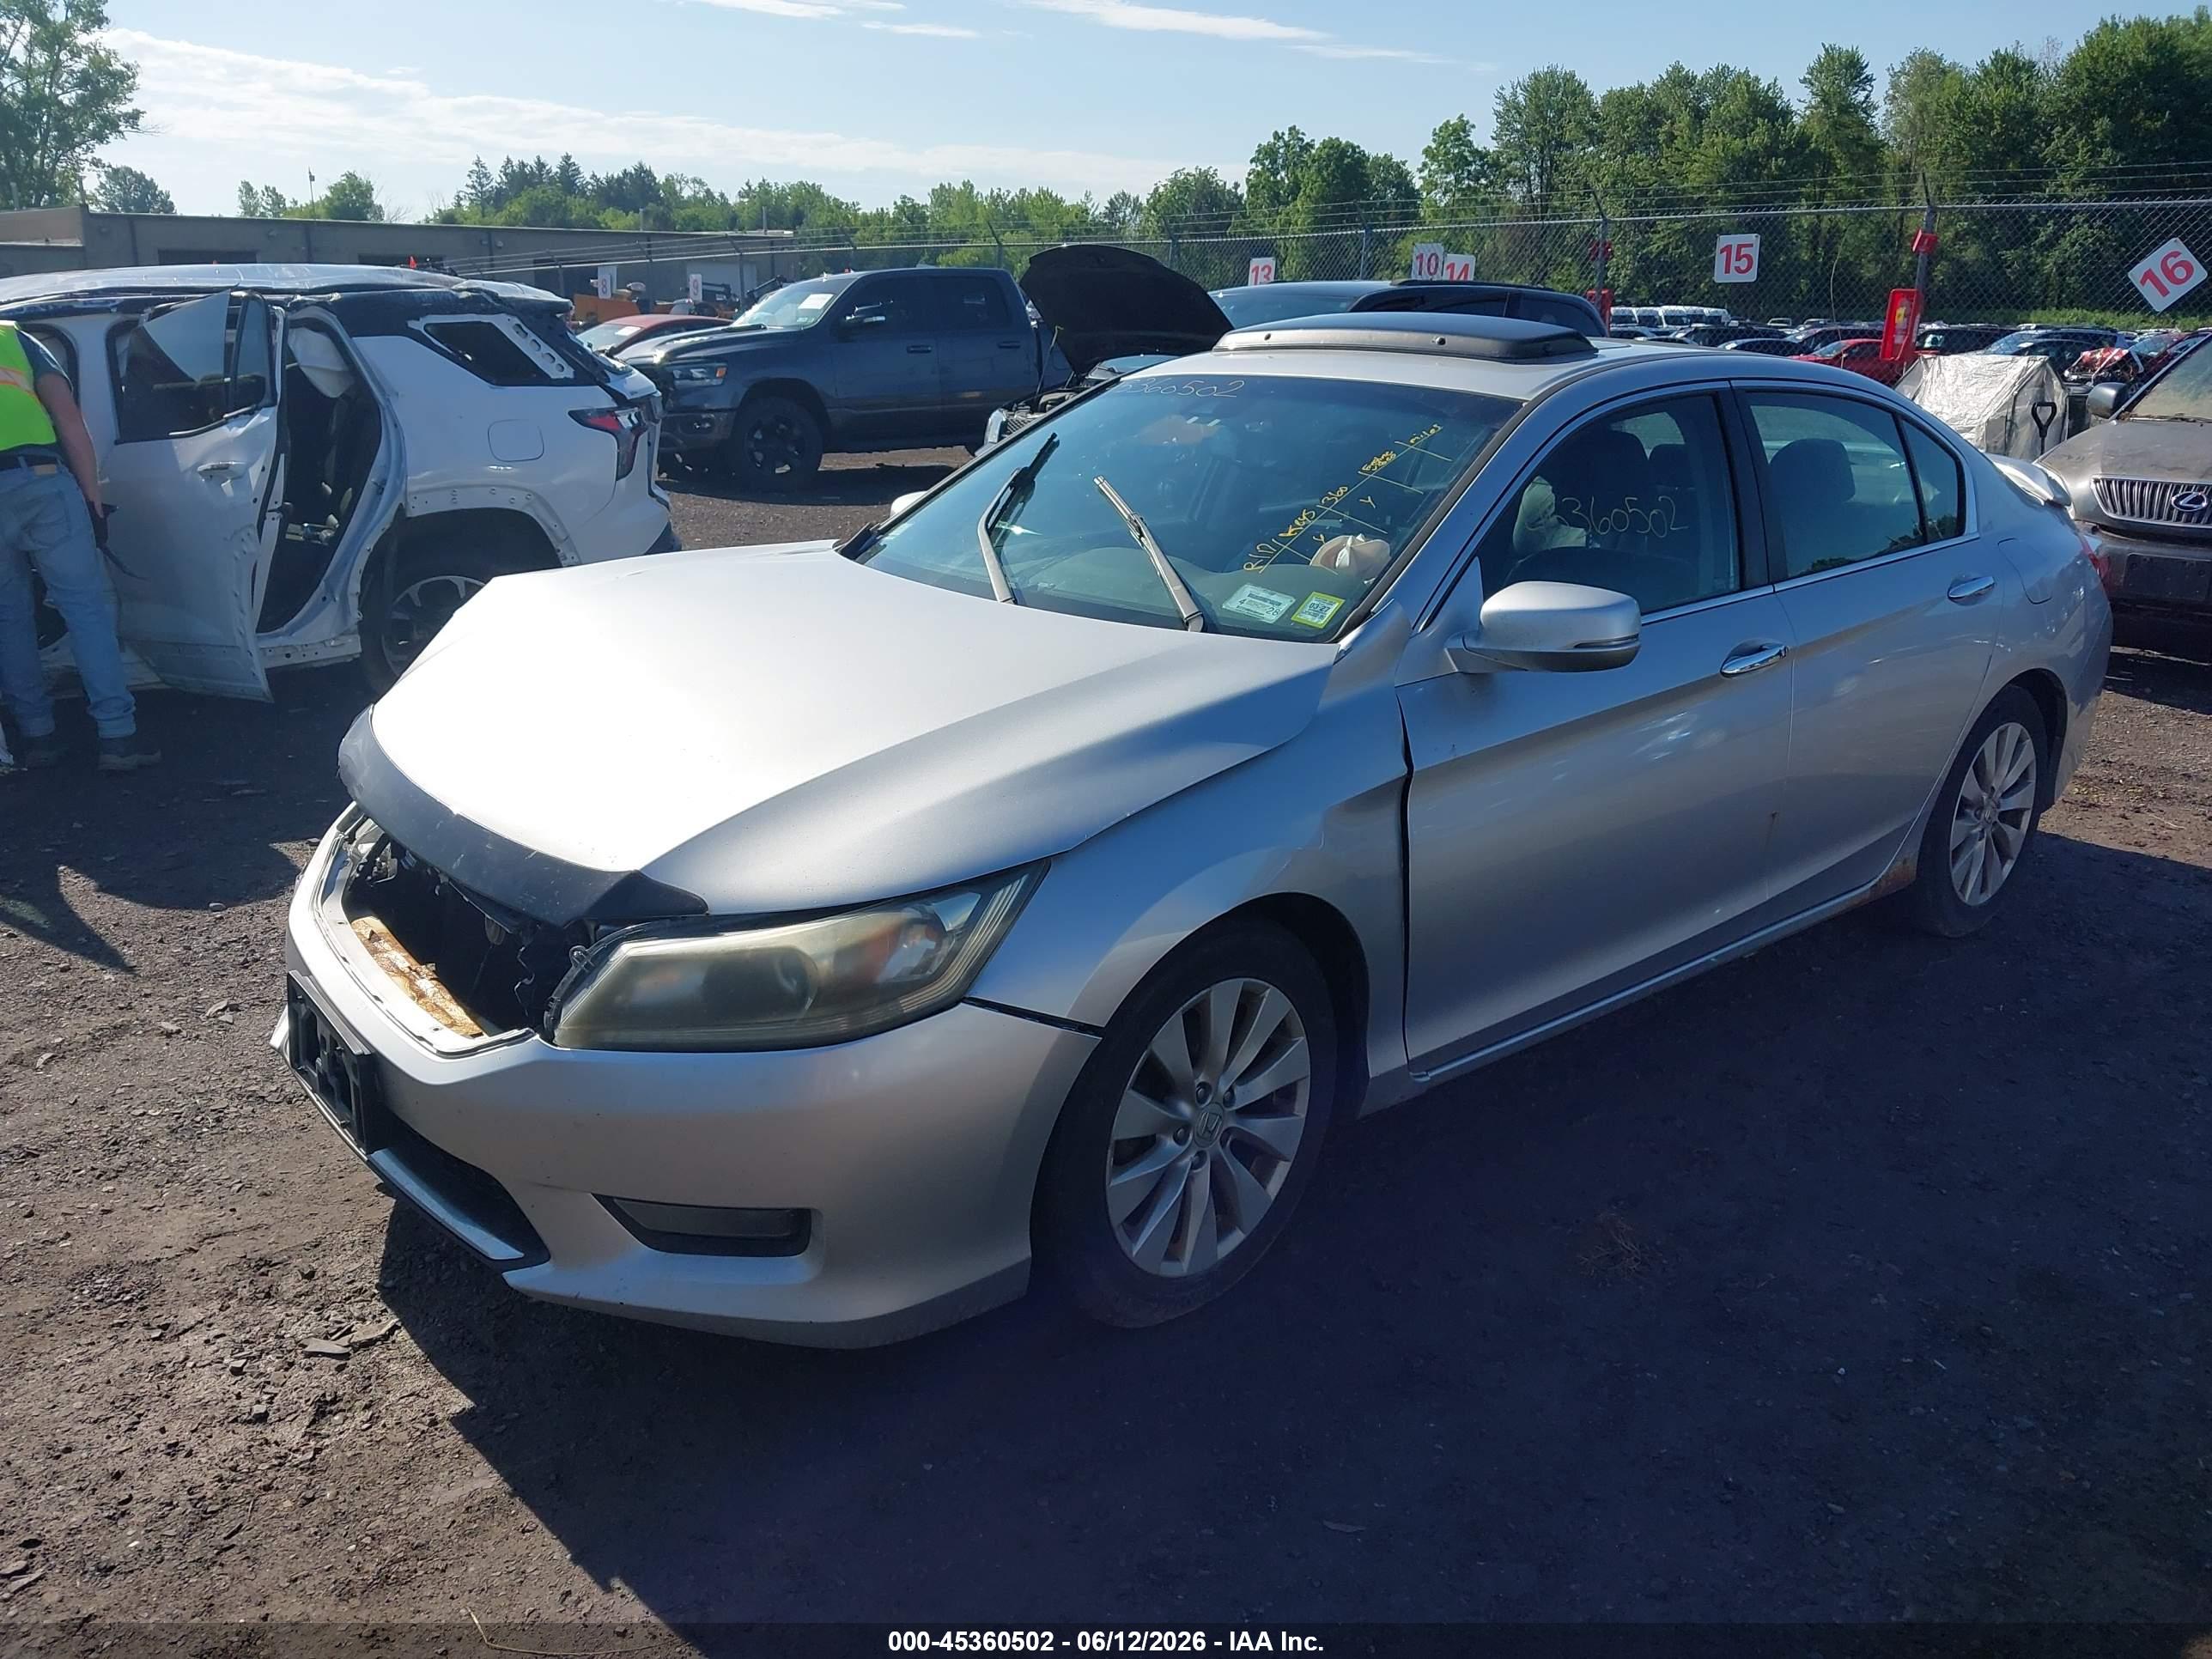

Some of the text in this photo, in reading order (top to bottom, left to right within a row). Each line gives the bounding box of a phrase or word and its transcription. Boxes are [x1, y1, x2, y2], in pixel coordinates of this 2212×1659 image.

[1416, 252, 1440, 276] 10
[1720, 243, 1754, 275] 15
[1251, 264, 1273, 286] 13
[1446, 262, 1470, 282] 14
[2140, 251, 2195, 297] 16
[601, 278, 607, 295] 8
[692, 279, 699, 295] 9
[1321, 486, 1348, 507] 360
[1358, 495, 1376, 509] Y
[1265, 607, 1280, 616] 28
